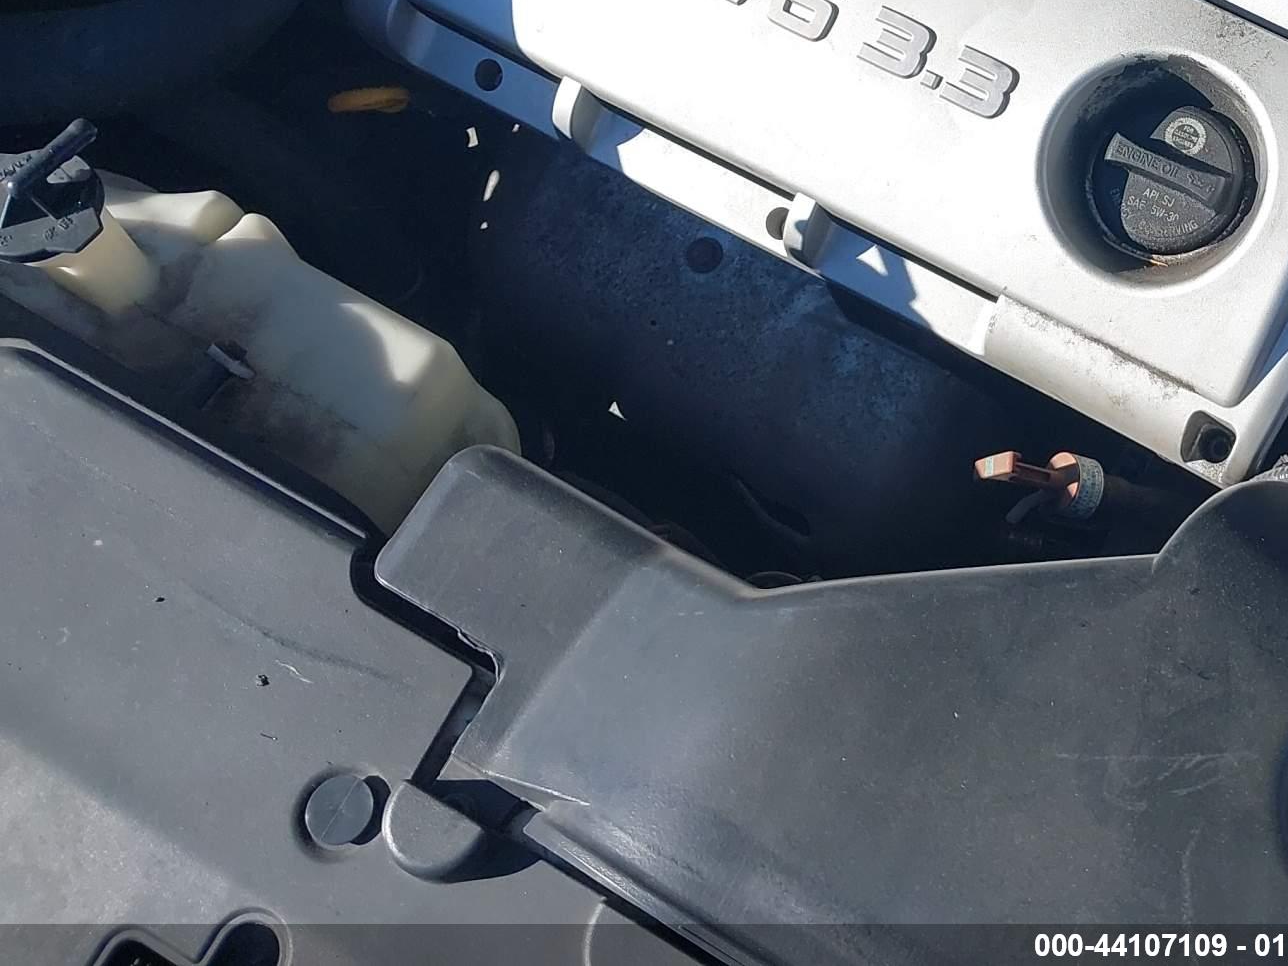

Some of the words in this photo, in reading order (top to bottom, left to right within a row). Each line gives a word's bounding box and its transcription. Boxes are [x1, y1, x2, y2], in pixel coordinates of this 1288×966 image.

[857, 5, 1020, 119] 3.3
[1115, 142, 1162, 170] ENGINE
[1159, 162, 1180, 179] OIL
[1126, 195, 1148, 211] SAE
[1149, 203, 1181, 223] 5W-30
[1142, 187, 1160, 200] API
[1160, 193, 1176, 208] SJ
